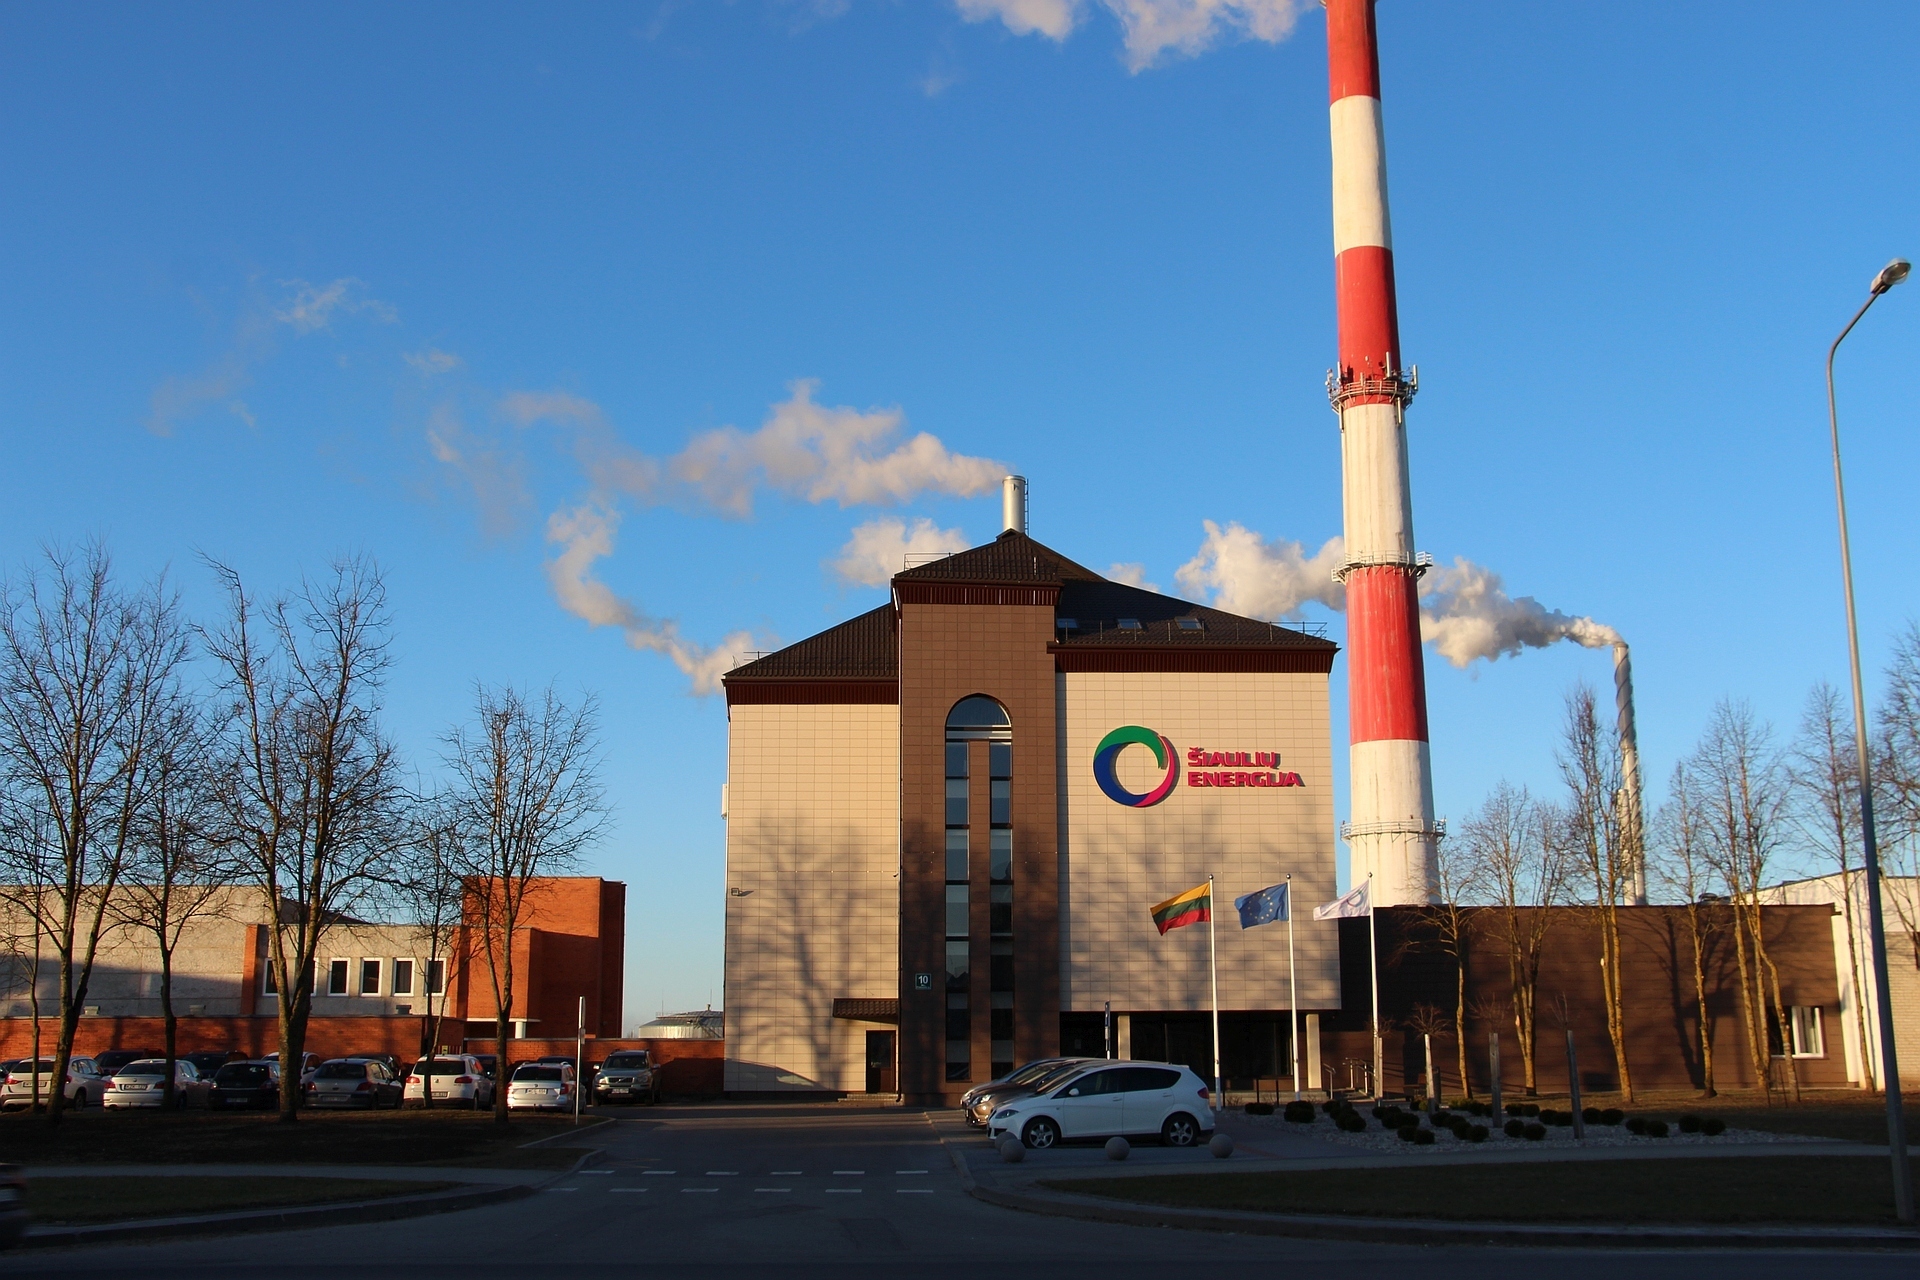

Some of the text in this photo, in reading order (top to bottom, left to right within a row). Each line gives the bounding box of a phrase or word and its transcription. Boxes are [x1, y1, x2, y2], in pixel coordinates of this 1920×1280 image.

[1187, 746, 1278, 769] ŠIAULIŲ
[1187, 771, 1302, 787] ENERGIJA
[918, 975, 929, 984] 10
